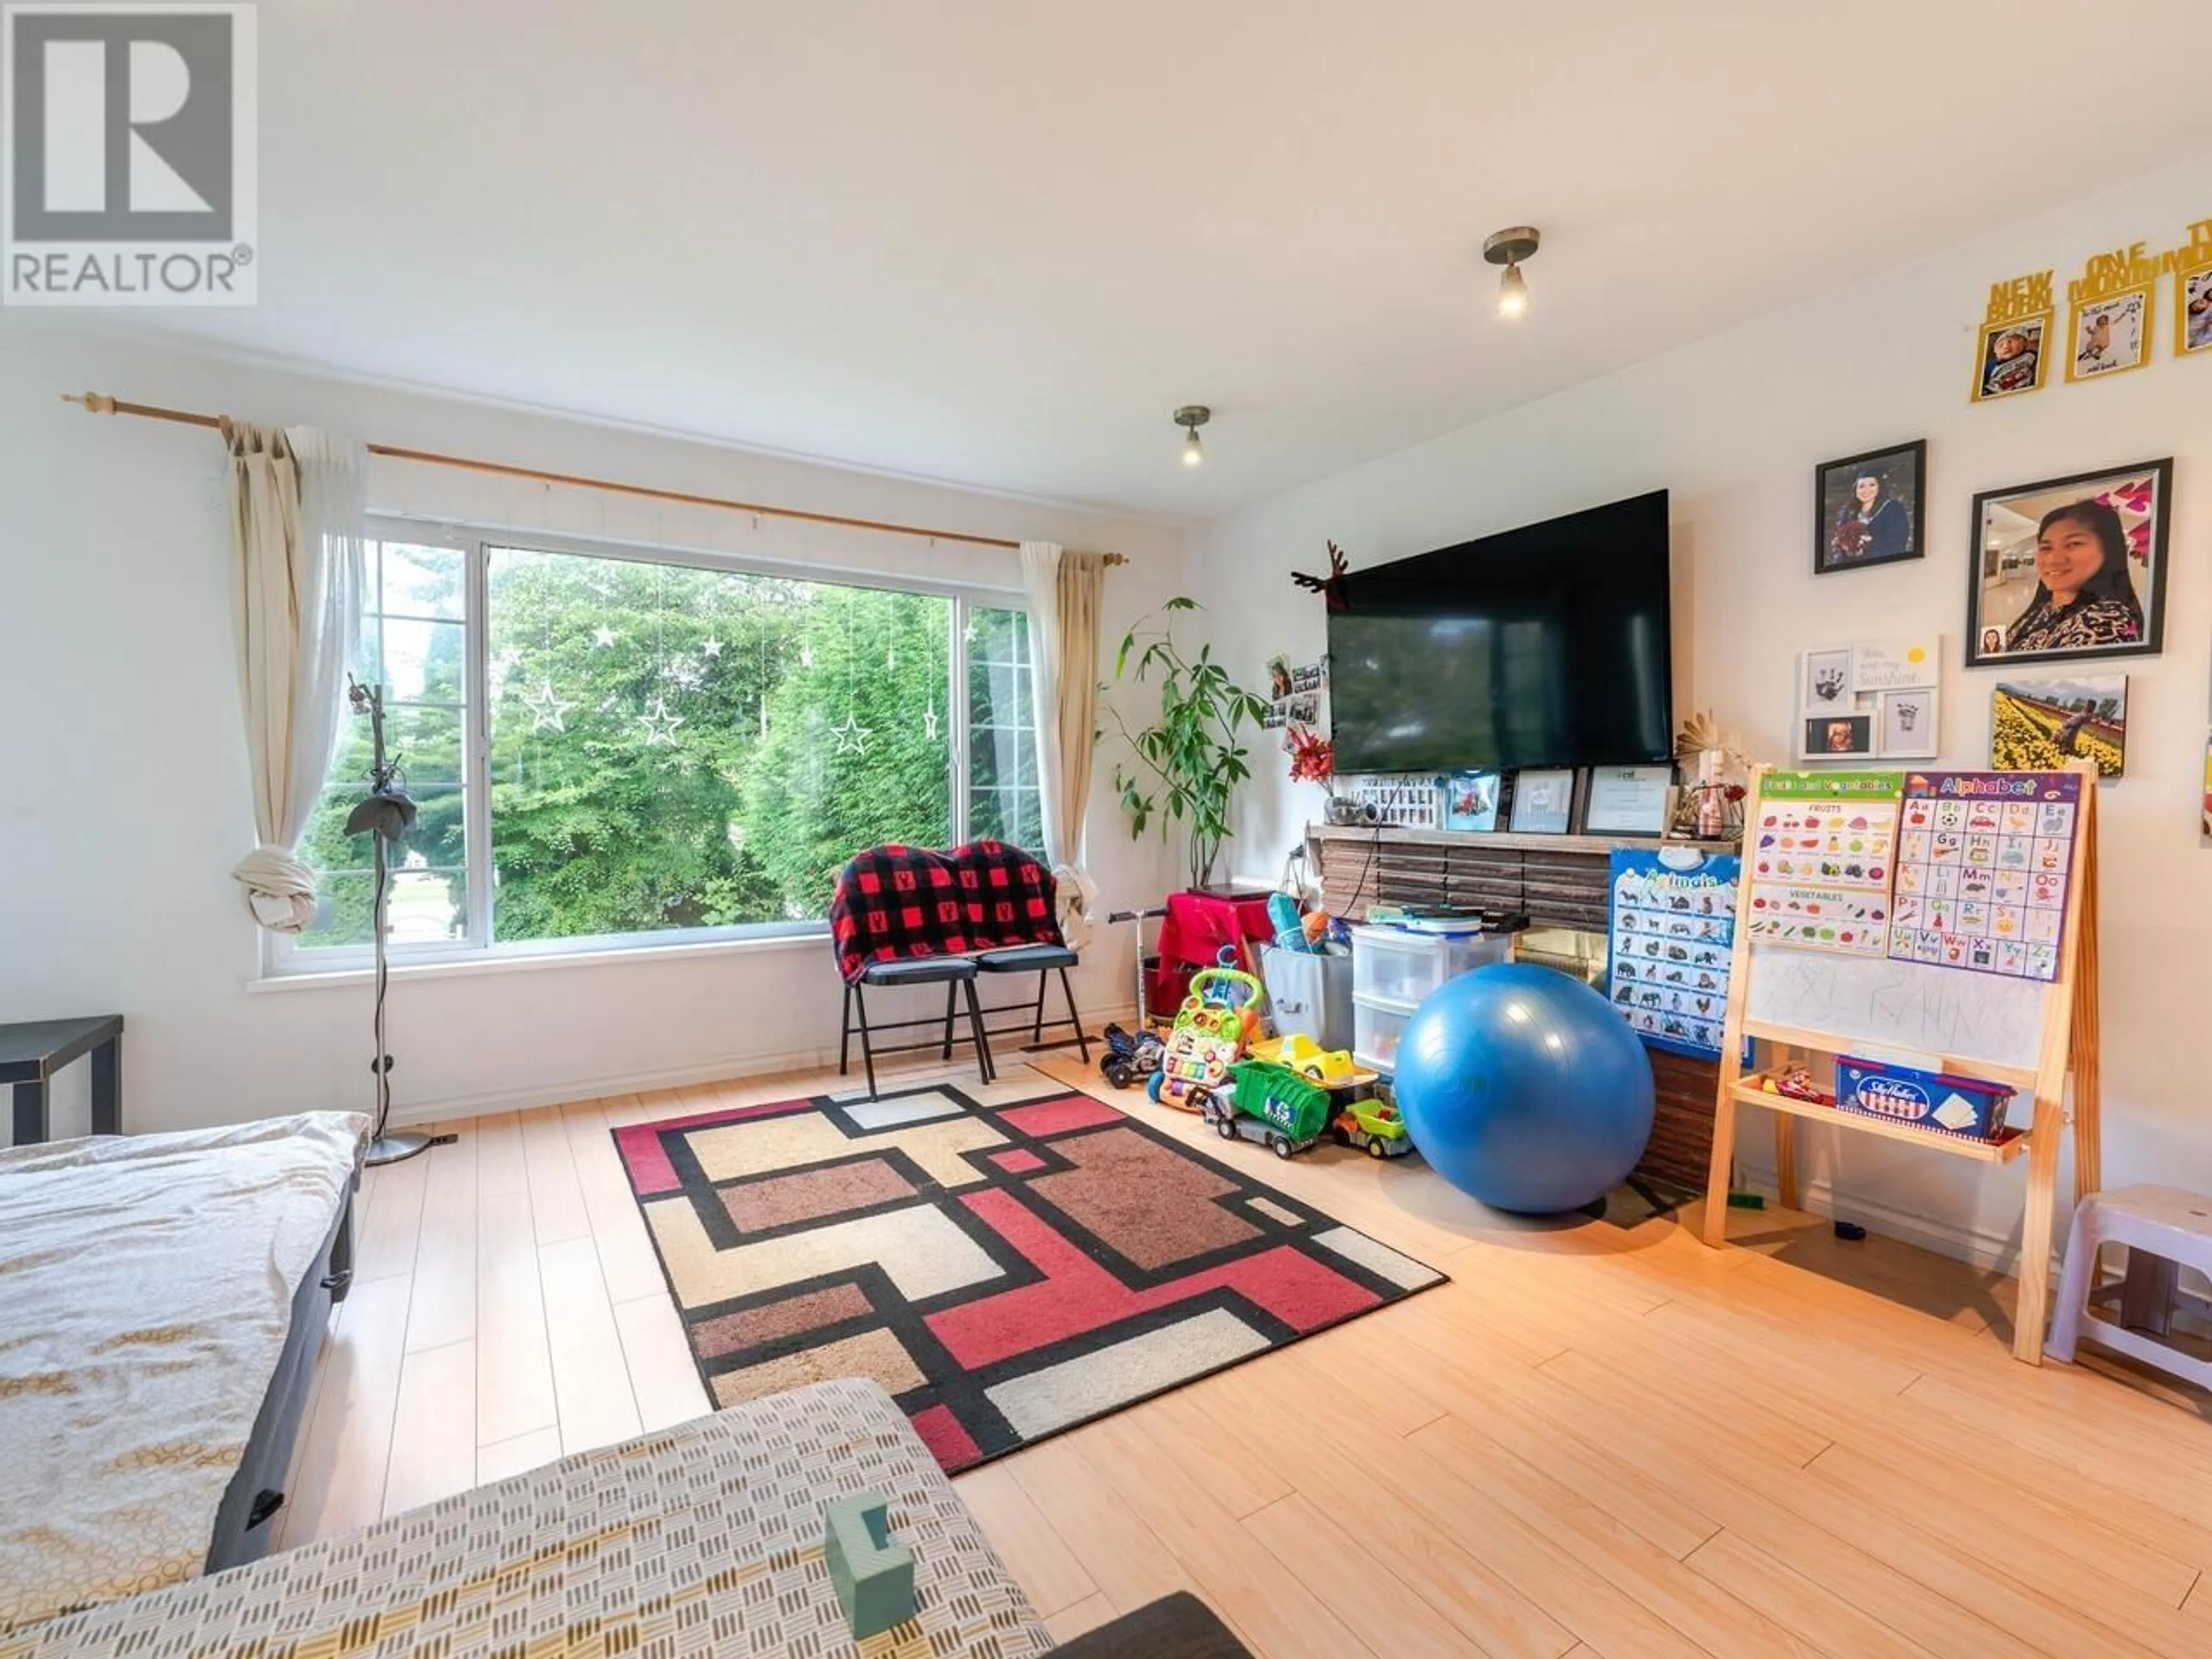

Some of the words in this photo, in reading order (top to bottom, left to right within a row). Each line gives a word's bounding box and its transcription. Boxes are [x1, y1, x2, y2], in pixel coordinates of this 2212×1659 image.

[2086, 241, 2146, 276] ONE
[1991, 270, 2054, 302] NEW
[1940, 777, 2037, 797] Alphabet
[1645, 869, 1718, 888] Animals
[1789, 891, 1843, 901] VEGETABLES
